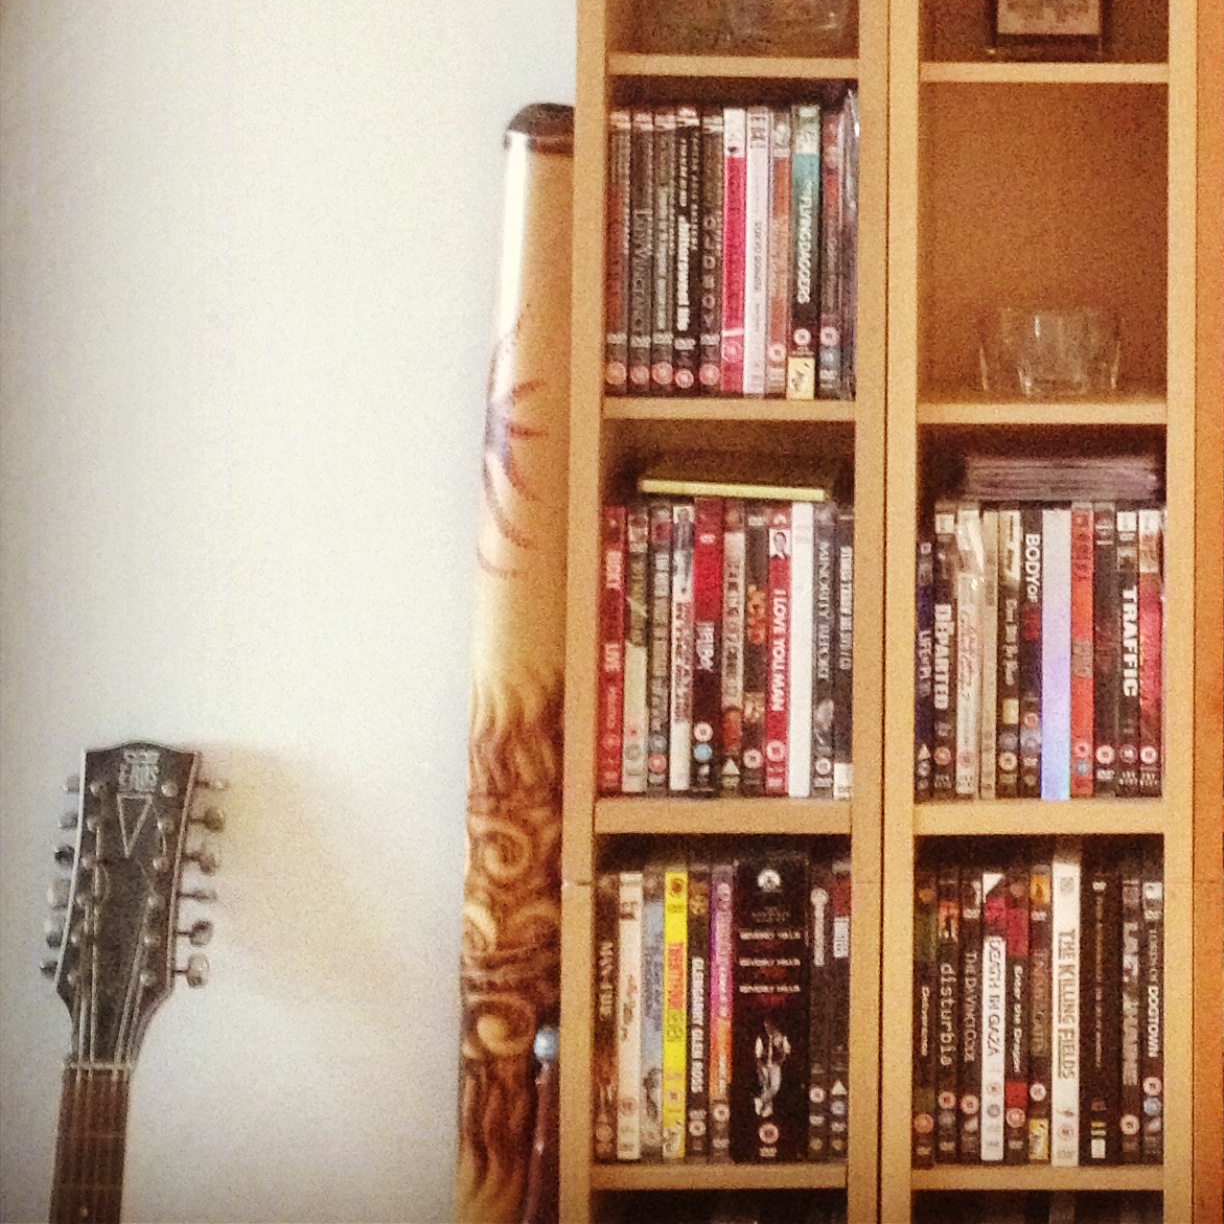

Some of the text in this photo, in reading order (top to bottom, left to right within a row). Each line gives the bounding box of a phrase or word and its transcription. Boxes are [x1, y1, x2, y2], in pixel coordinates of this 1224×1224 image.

[798, 196, 812, 304] FLYING DAGGERS
[1025, 534, 1041, 585] BODY
[1027, 584, 1039, 604] OF
[772, 597, 786, 635] LOVE
[818, 541, 831, 681] MINORITY REPORT
[919, 630, 932, 658] LIFE
[1122, 585, 1138, 697] TRAFFIC
[772, 637, 786, 671] YOU
[934, 604, 952, 711] DEPARTED
[772, 672, 786, 712] MAN
[963, 951, 977, 975] THE
[987, 939, 1001, 1058] DEATH IN GAZA
[690, 956, 705, 1094] GLENGARRY GLEN ROSS
[939, 962, 957, 1067] disturbia
[963, 994, 977, 1028] VINCI
[1012, 965, 1023, 1073] Enter the Dragon
[1057, 928, 1076, 1080] THE KILLING FIELDS
[1147, 985, 1160, 1058] DOGTOWN
[963, 1028, 977, 1062] CODE
